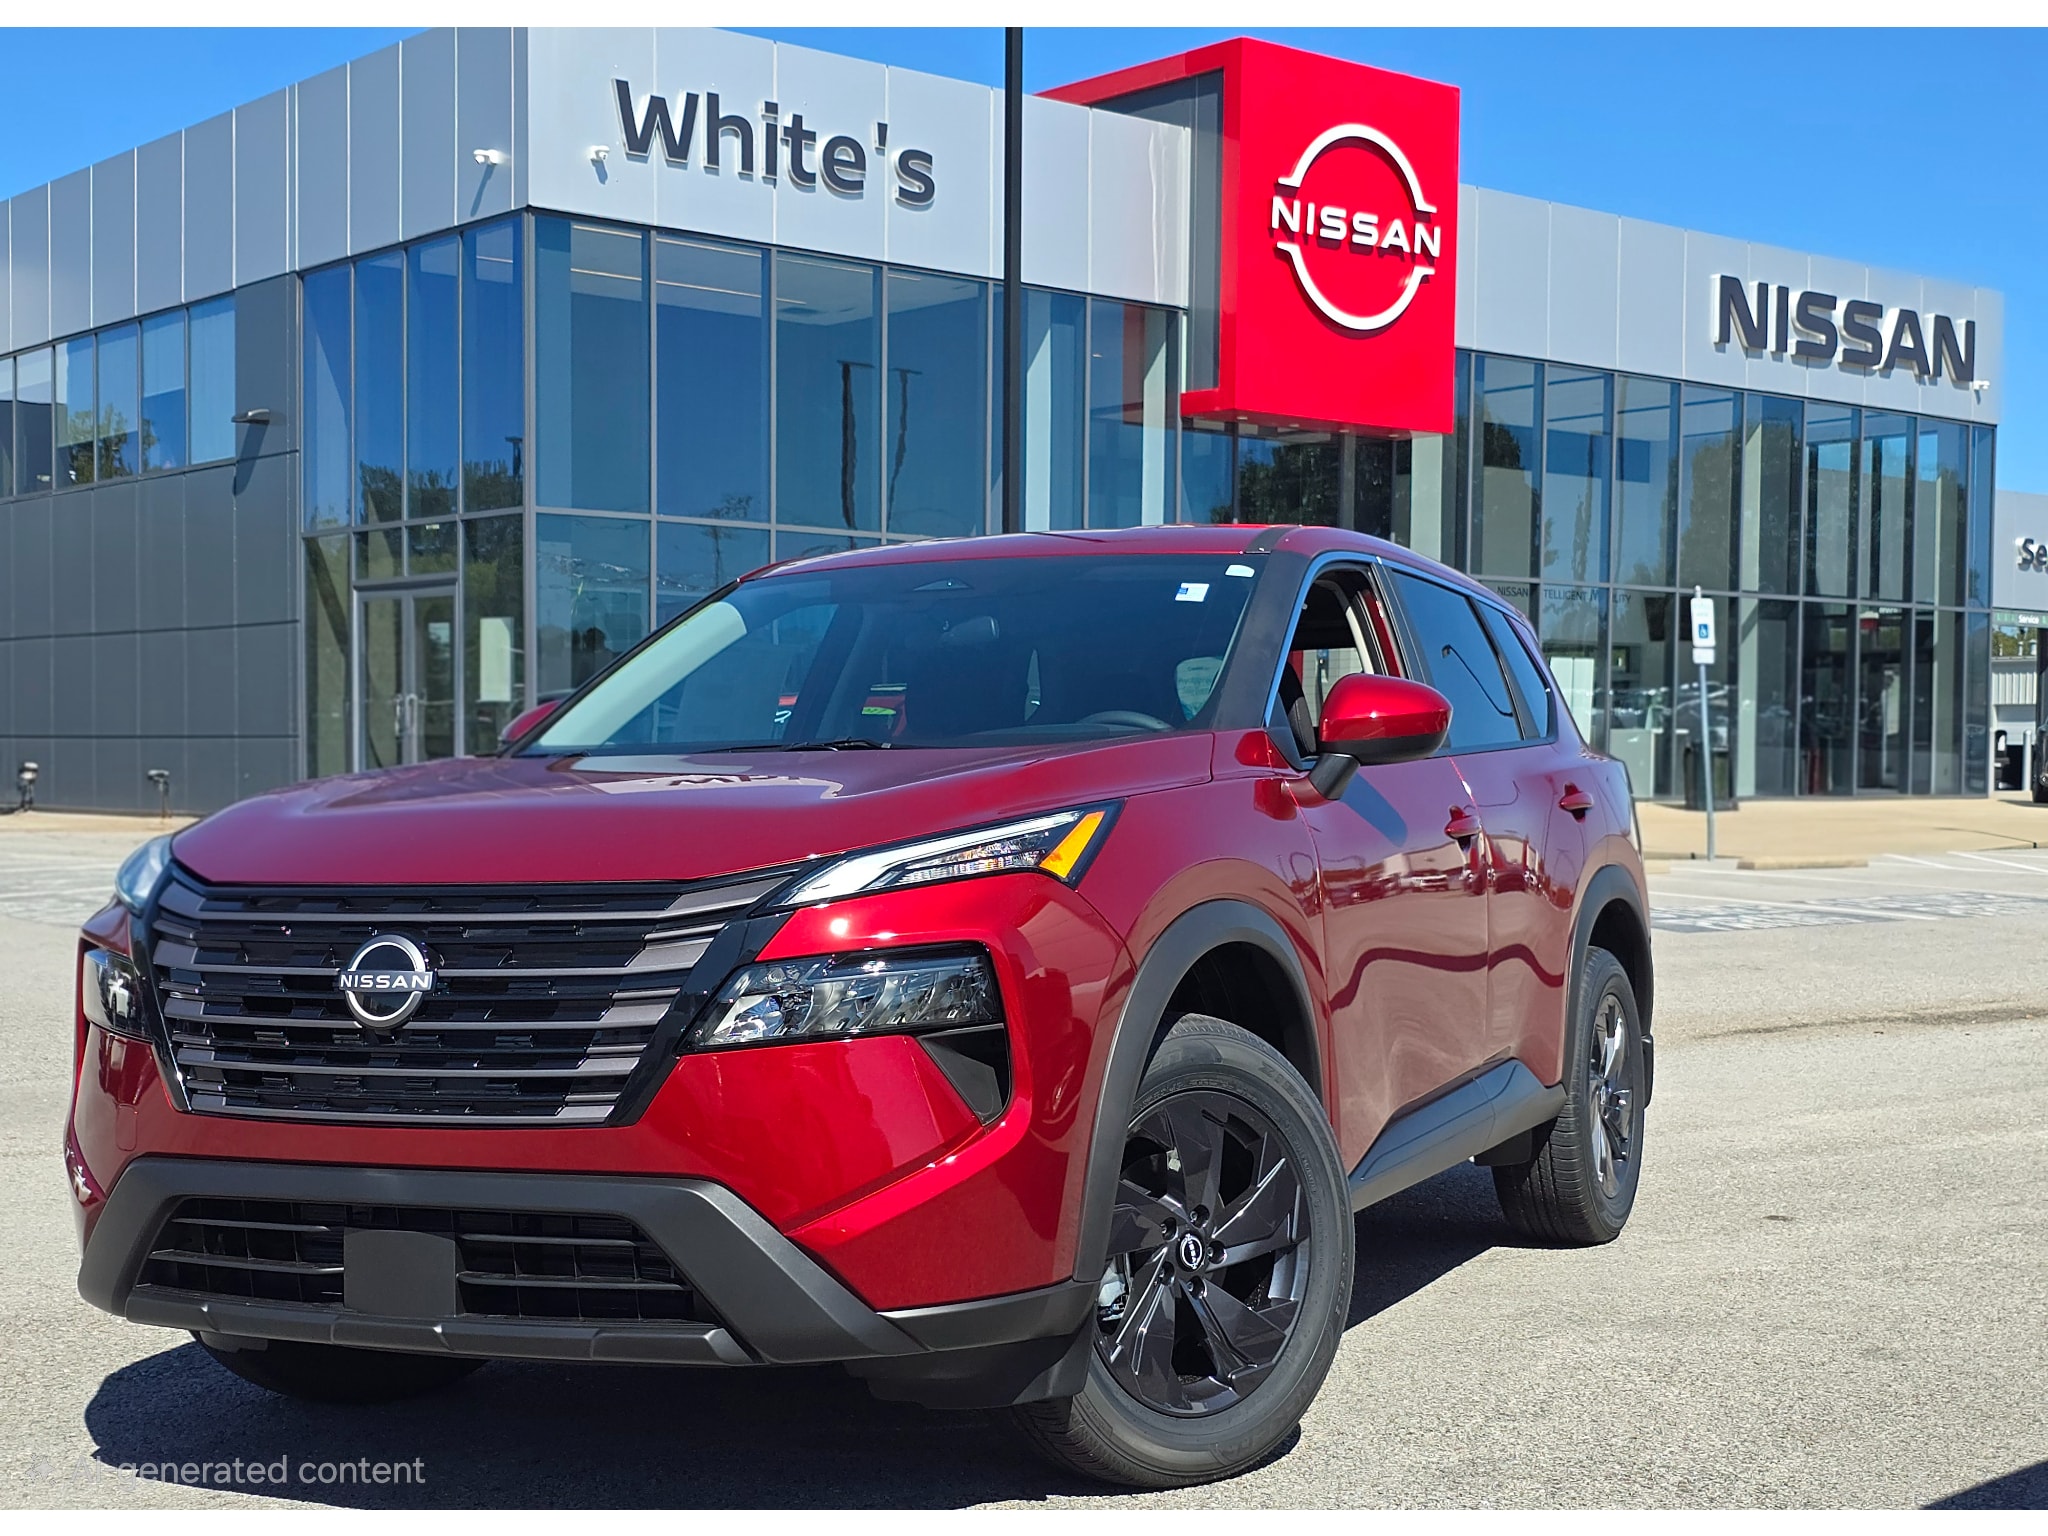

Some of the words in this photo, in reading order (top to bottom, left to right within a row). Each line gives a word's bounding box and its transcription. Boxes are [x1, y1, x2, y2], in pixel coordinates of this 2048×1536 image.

[612, 78, 936, 205] White's
[1271, 195, 1441, 258] NISSAN
[1711, 274, 1975, 383] NISSAN
[2017, 537, 2048, 567] Se
[1497, 585, 1528, 598] NISSAN
[1544, 588, 1586, 601] TELLIGENT
[340, 974, 429, 989] NISSAN
